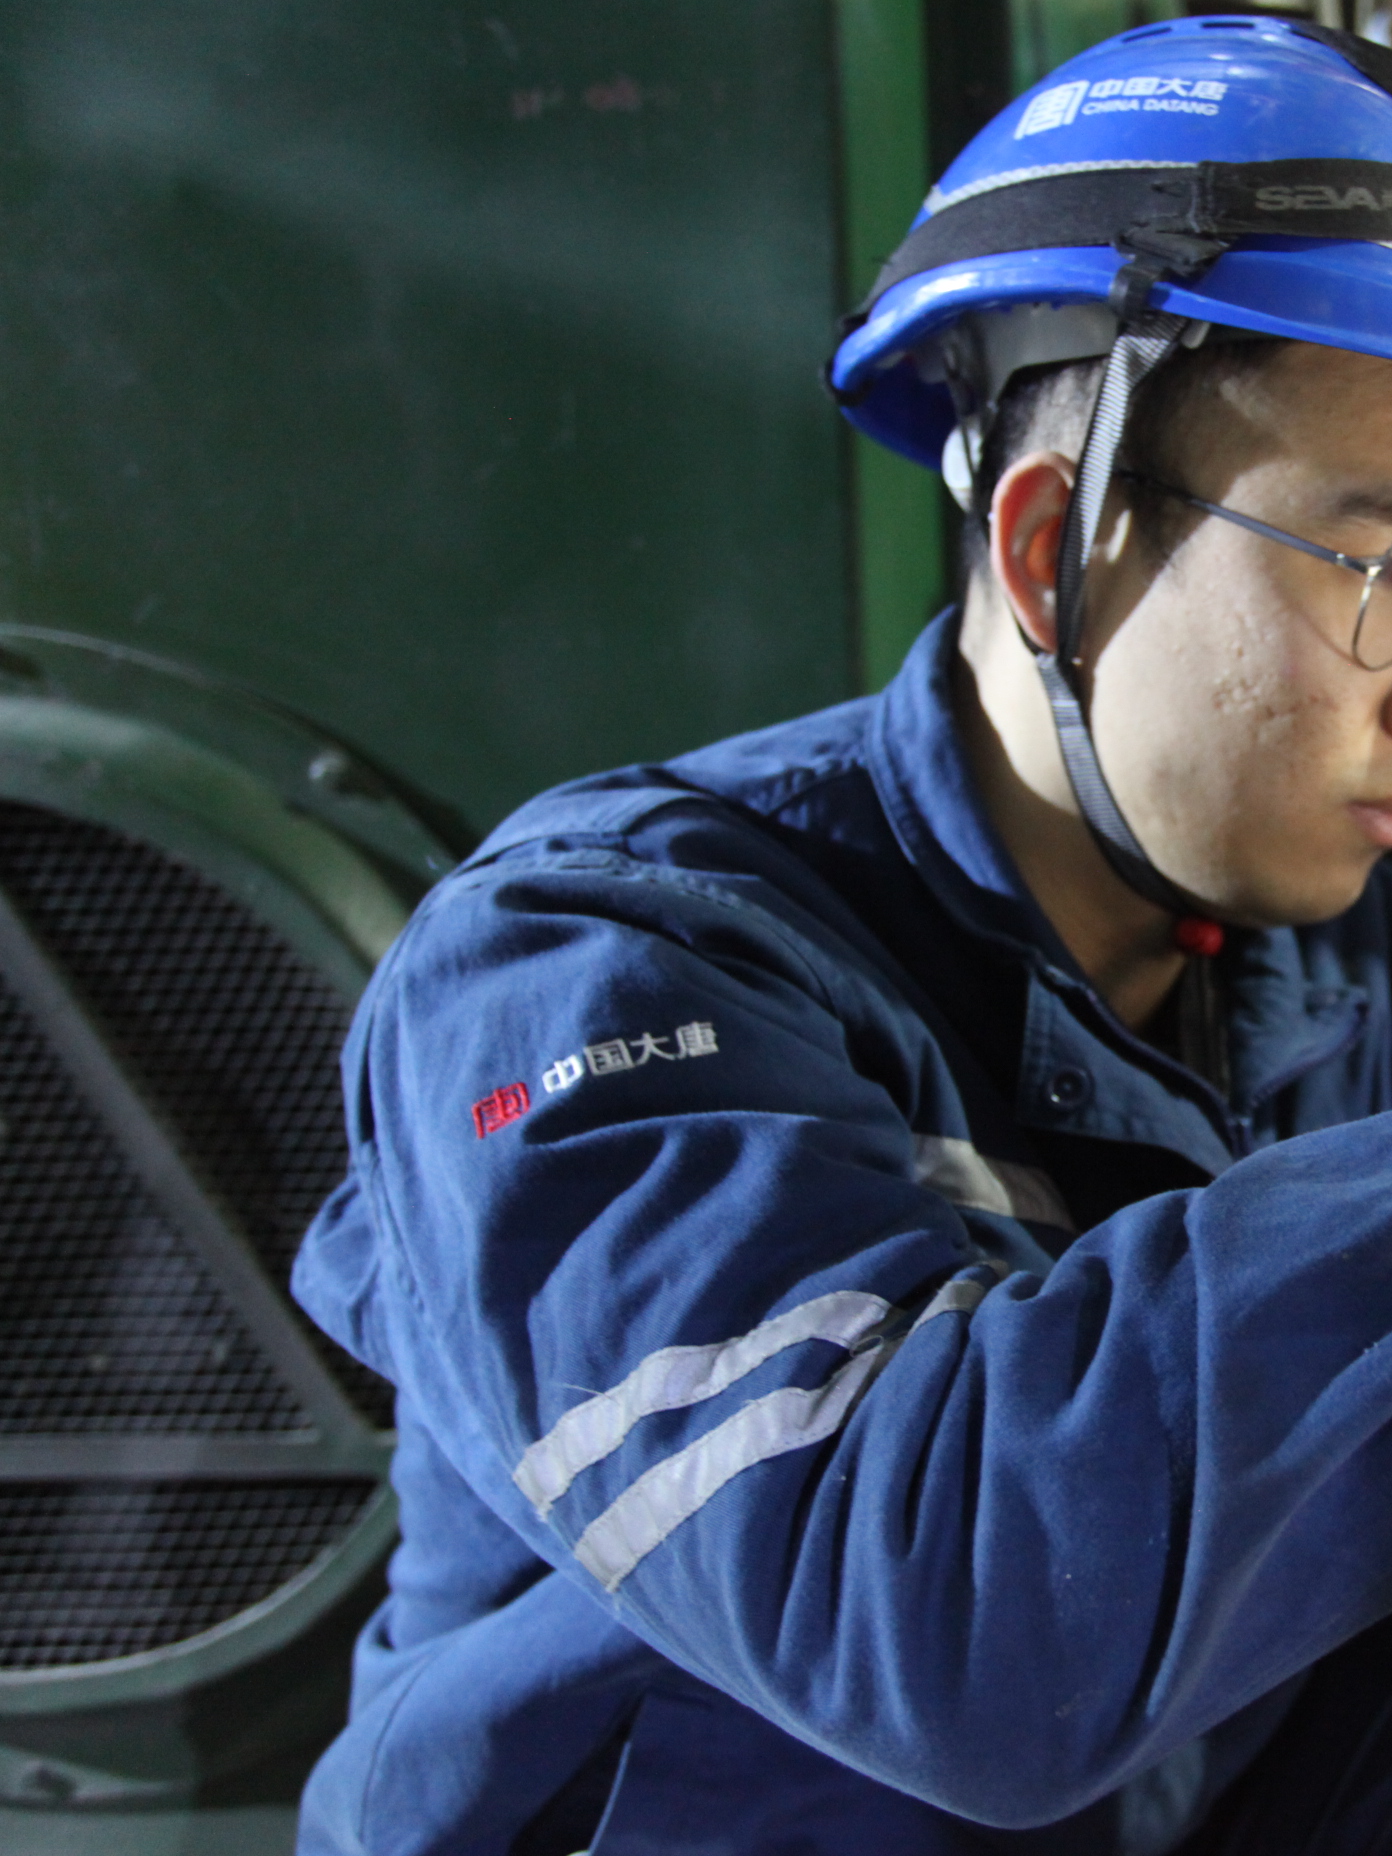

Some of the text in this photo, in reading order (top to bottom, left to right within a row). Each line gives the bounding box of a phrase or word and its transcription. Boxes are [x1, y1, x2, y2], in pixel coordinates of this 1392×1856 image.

[1088, 76, 1228, 101] 中国大唐
[1081, 98, 1220, 117] CHINA DATANG
[542, 1020, 720, 1094] 中国大唐
